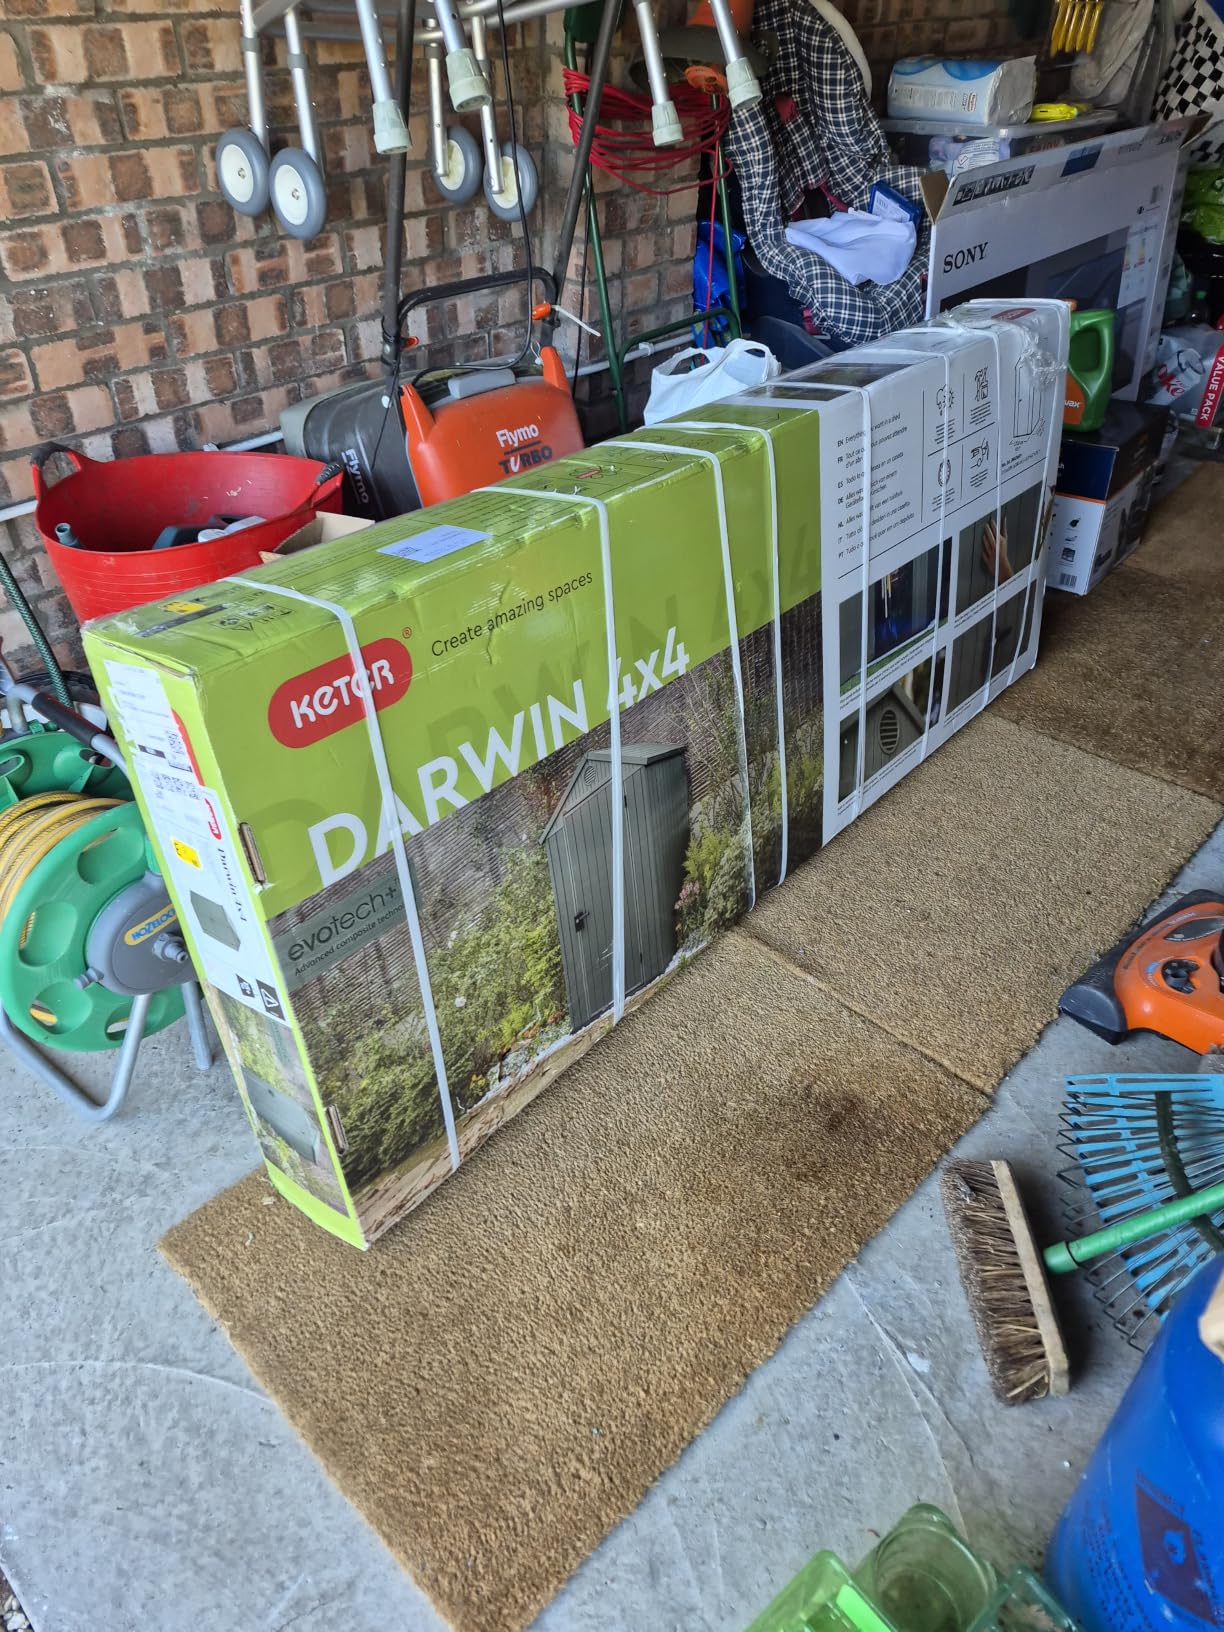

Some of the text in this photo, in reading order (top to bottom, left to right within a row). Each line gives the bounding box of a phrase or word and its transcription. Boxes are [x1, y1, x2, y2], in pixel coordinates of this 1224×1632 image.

[943, 241, 989, 274] SONY
[1200, 356, 1224, 421] VALUE PACK
[496, 423, 539, 447] Flymo
[498, 444, 553, 475] TURBO
[345, 449, 369, 504] Flymo
[431, 571, 593, 657] Create amazing spaces
[308, 679, 588, 888] DARWIN
[131, 908, 177, 941] HOZELOC
[288, 886, 397, 961] evotech+
[295, 945, 335, 976] Advanced
[335, 920, 376, 950] composite
